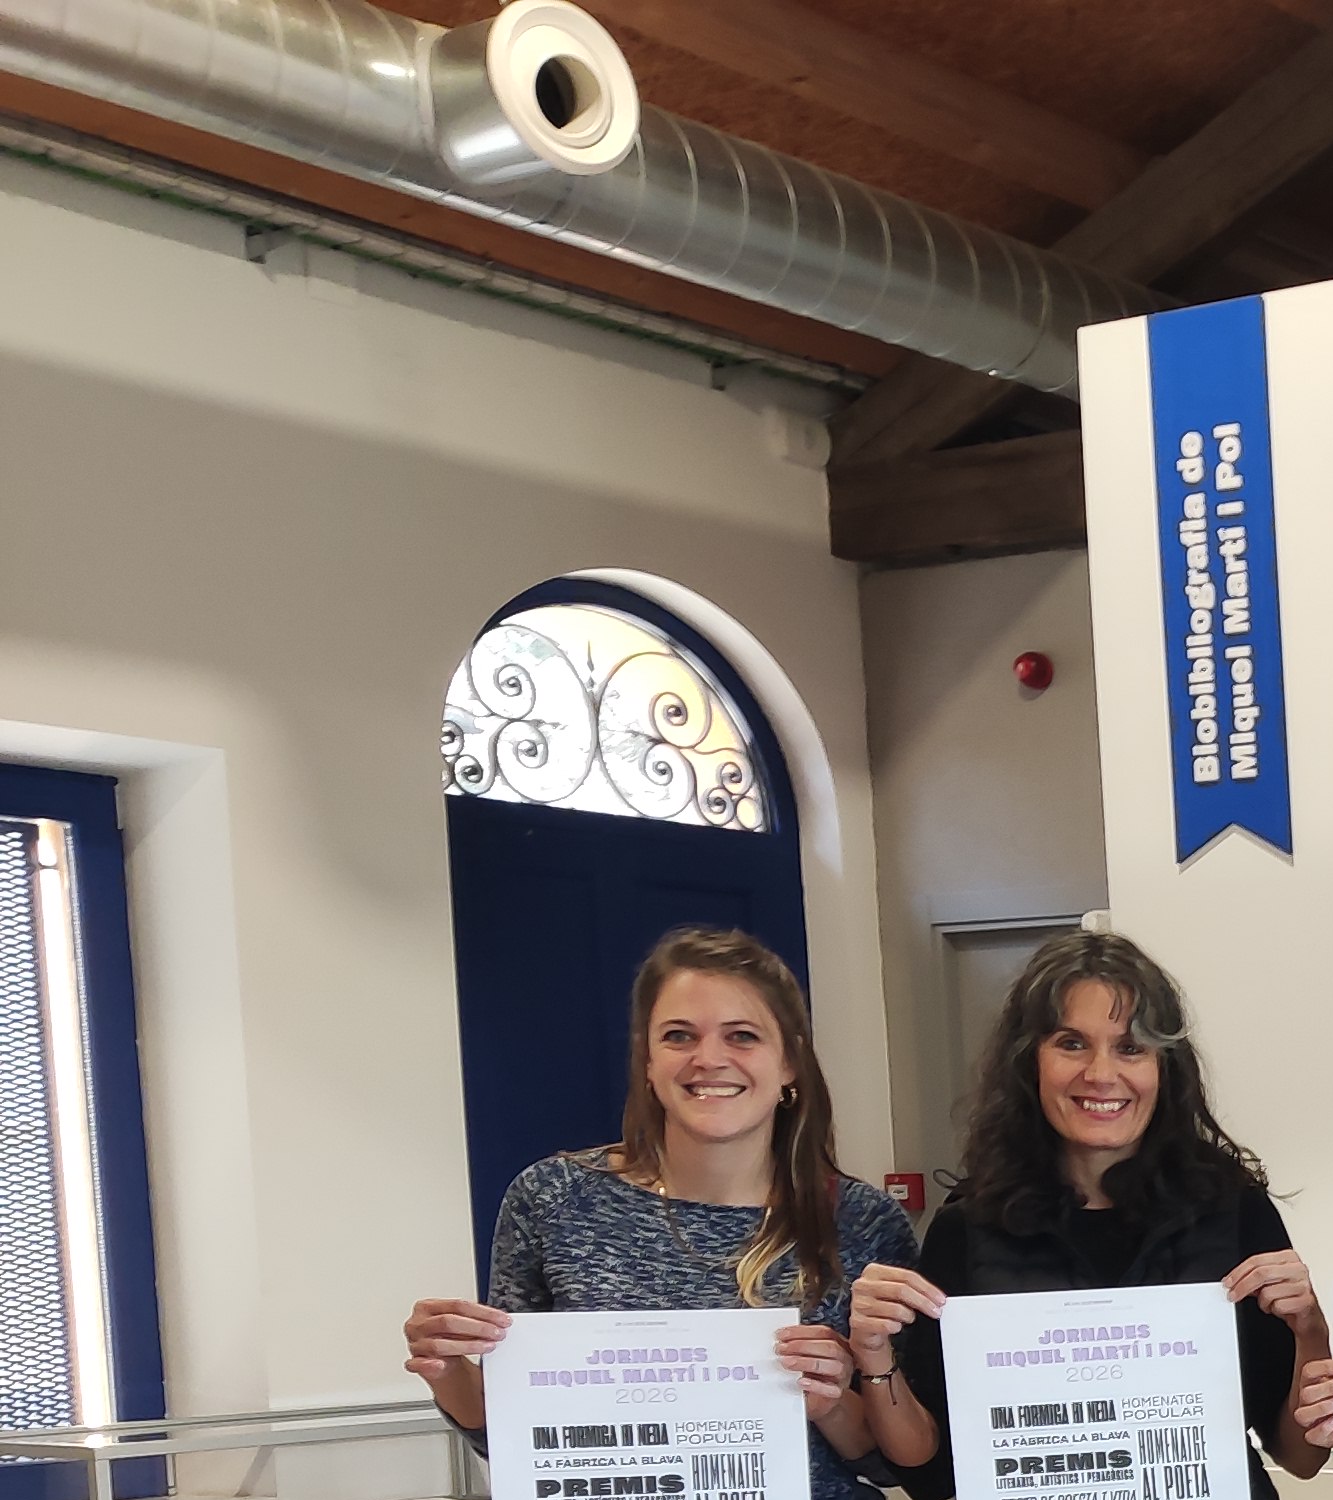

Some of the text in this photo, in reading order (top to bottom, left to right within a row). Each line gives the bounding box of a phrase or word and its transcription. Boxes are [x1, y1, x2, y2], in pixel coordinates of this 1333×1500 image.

[1213, 422, 1243, 491] Pol
[1217, 526, 1250, 634] Martí
[1175, 431, 1221, 783] Biobibliografia de
[1225, 645, 1260, 780] Miquel
[1039, 1324, 1150, 1345] JORNADES
[586, 1348, 708, 1365] JORNADES
[987, 1339, 1197, 1367] MIQUEL MARTÍ I POL
[529, 1362, 759, 1387] MIQUEL MARTÍ I POL
[1066, 1364, 1123, 1382] 2026
[616, 1388, 678, 1404] 2026
[675, 1420, 764, 1433] HOMENATGE
[676, 1431, 764, 1445] POPULAR
[1138, 1425, 1207, 1465] HOMENATGE
[995, 1450, 1133, 1477] PREMIS
[536, 1474, 685, 1498] PREMIS
[1163, 1462, 1210, 1500] POETA
